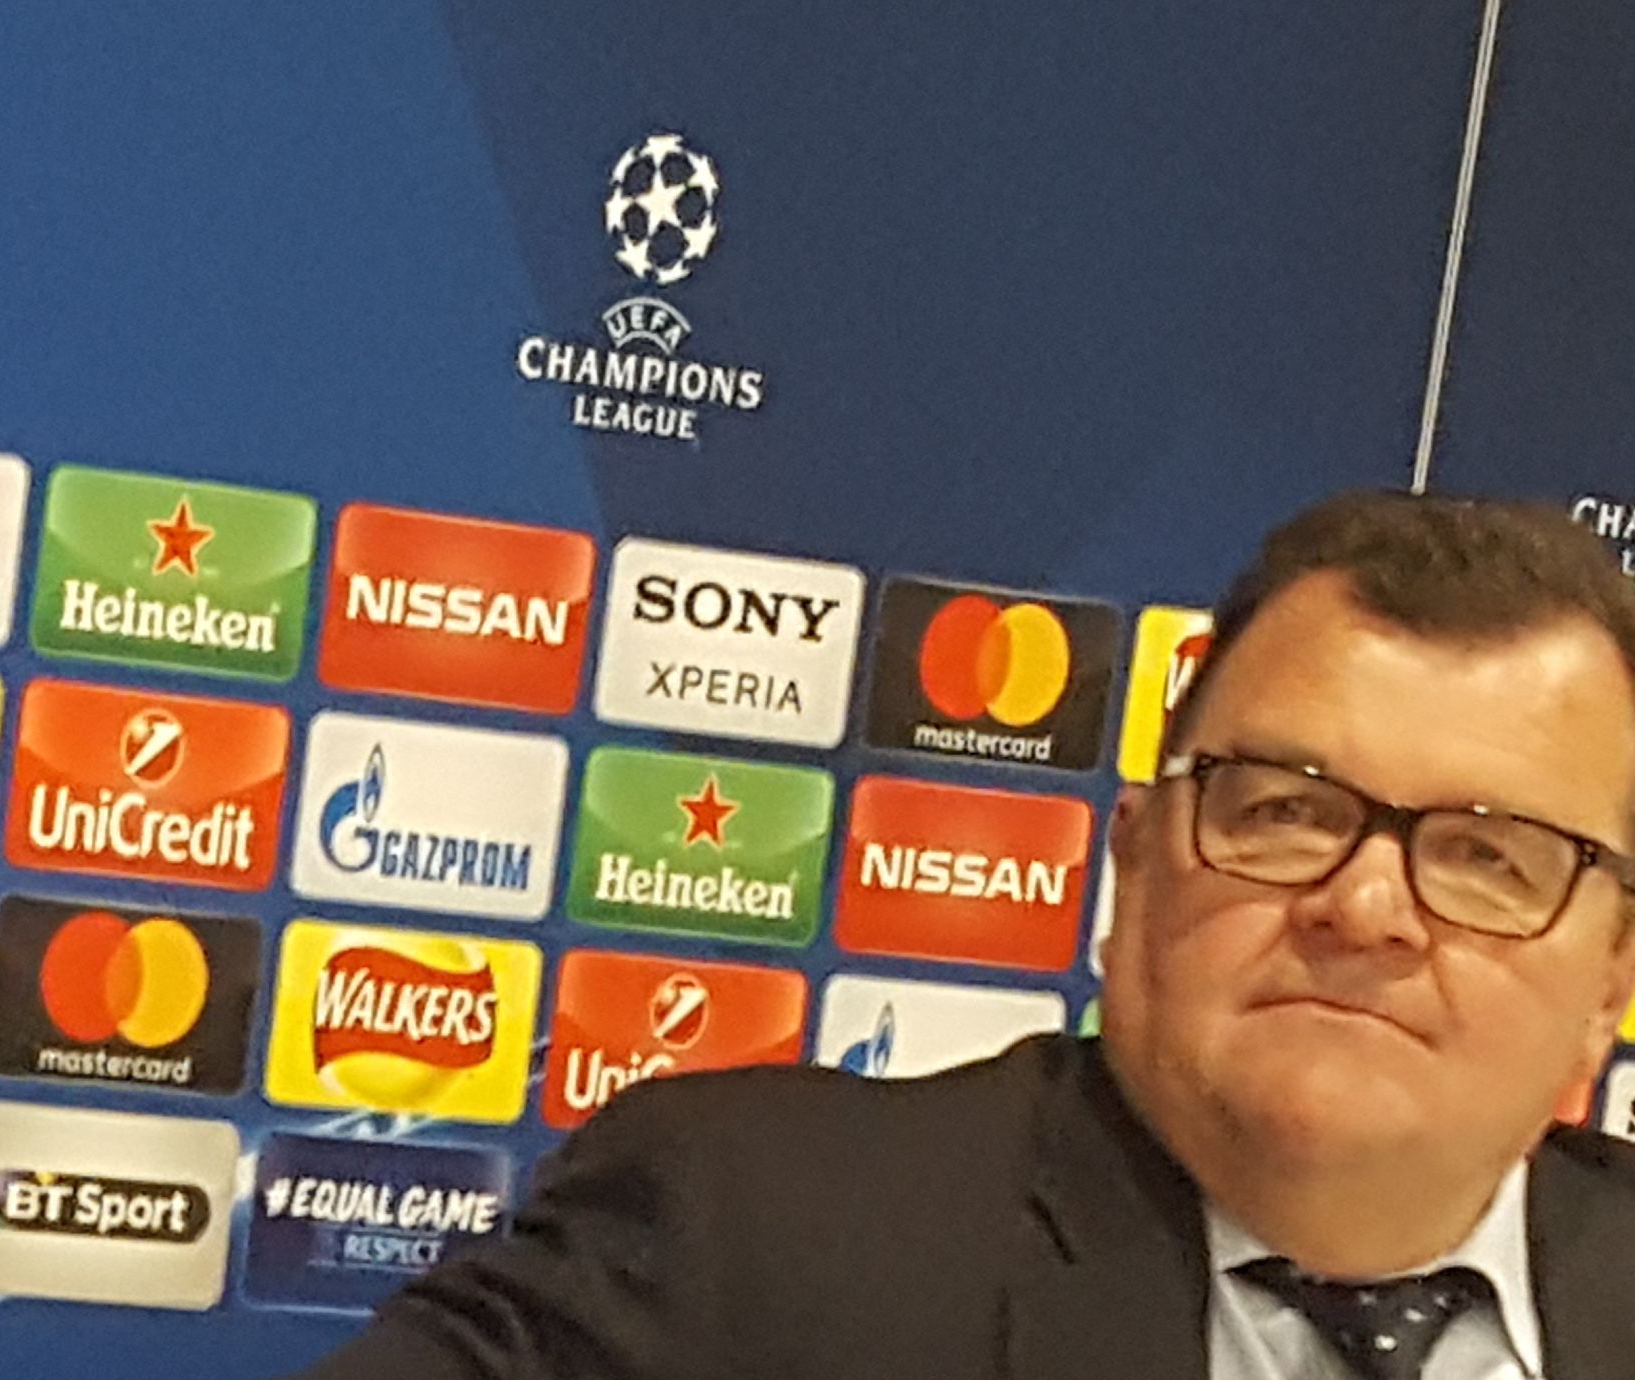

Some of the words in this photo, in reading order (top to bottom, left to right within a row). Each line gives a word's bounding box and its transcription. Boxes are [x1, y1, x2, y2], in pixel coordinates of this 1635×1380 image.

[608, 305, 681, 349] UEFA
[517, 336, 763, 409] CHAMPIONS
[573, 394, 698, 439] LEAGUE
[60, 580, 276, 654] Heineken
[346, 574, 570, 645] NISSAN
[633, 575, 840, 645] SONY
[647, 661, 804, 714] XPERIA
[915, 722, 1052, 762] mastercard
[29, 785, 255, 870] UniCredit
[379, 835, 530, 892] GAZPROM
[596, 854, 794, 920] Heineken
[861, 844, 1068, 905] NISSAN
[314, 969, 498, 1045] WALKERS
[38, 1047, 192, 1085] mastercard
[5, 1182, 72, 1222] BT
[76, 1183, 189, 1235] Sport
[398, 1184, 499, 1234] GAME
[343, 1234, 443, 1265] RESPECT
